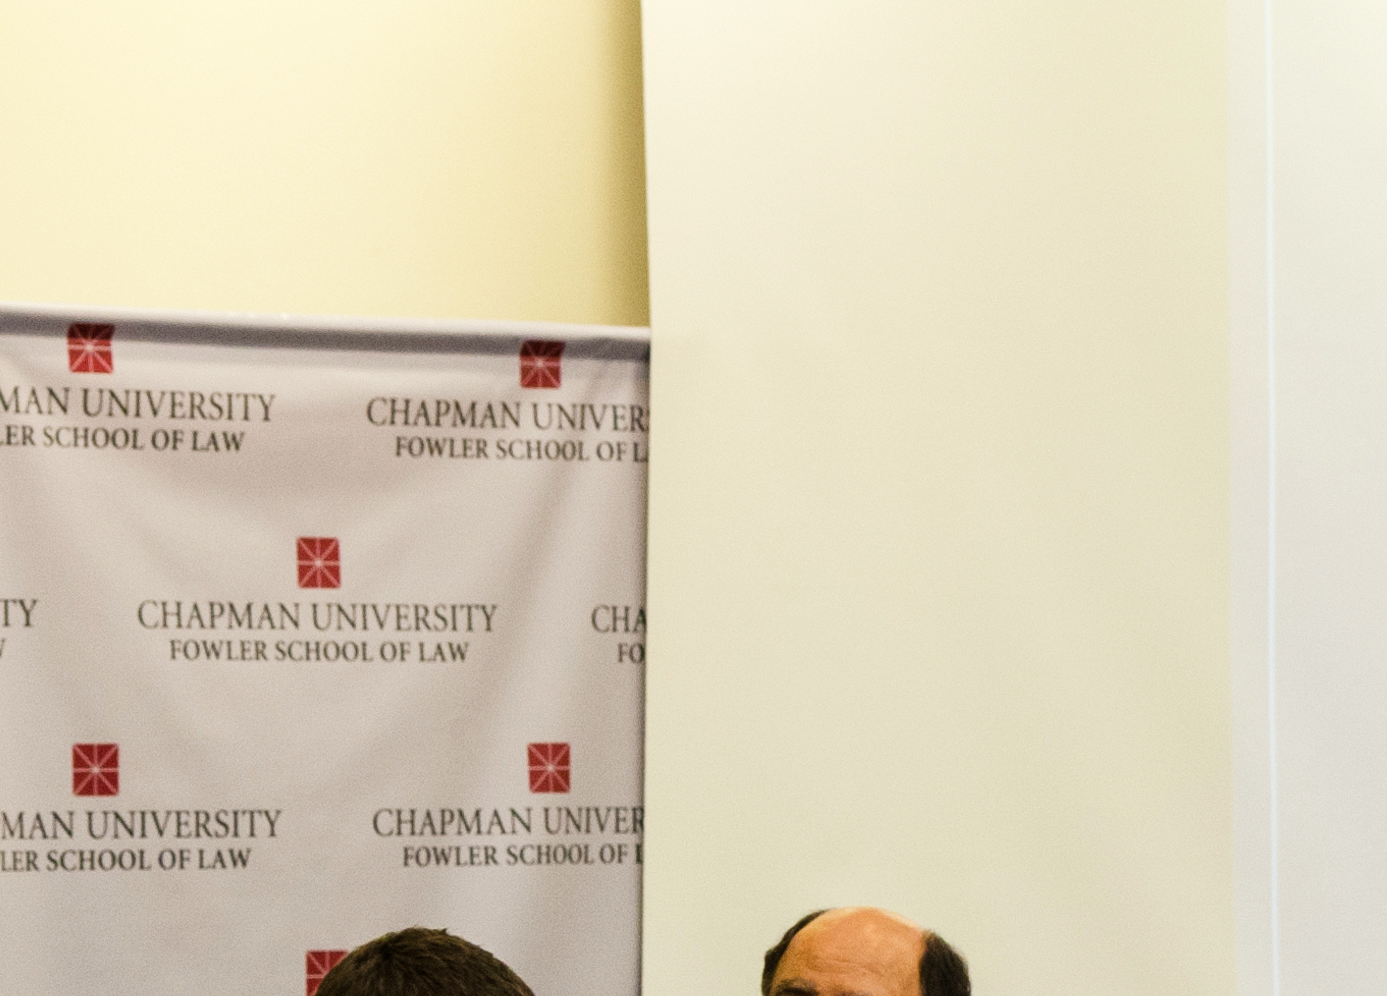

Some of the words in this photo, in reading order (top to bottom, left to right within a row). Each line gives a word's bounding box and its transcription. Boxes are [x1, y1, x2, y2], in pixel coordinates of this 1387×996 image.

[81, 387, 276, 422] UNIVERSITY
[366, 396, 520, 429] CHAPMAN
[532, 402, 650, 432] UNIVER
[43, 426, 144, 450] SCHOOL
[151, 429, 184, 451] OF
[191, 430, 246, 453] LAW
[395, 436, 489, 459] FOWLER
[496, 438, 589, 462] SCHOOL
[596, 440, 626, 462] OF
[137, 600, 301, 630] CHAPMAN
[312, 602, 498, 632] UNIVERSITY
[168, 638, 269, 661] FOWLER
[274, 640, 374, 662] SCHOOL
[379, 641, 411, 662] OF
[418, 642, 469, 663] LAW
[86, 809, 282, 839] UNIVERSITY
[372, 808, 532, 837] CHAPMAN
[543, 806, 644, 835] UNIVER
[46, 849, 151, 871] SCHOOL
[158, 848, 191, 870] OF
[198, 847, 252, 869] LAW
[403, 845, 498, 867] FOWLER
[506, 844, 594, 866] SCHOOL
[599, 843, 629, 865] OF
